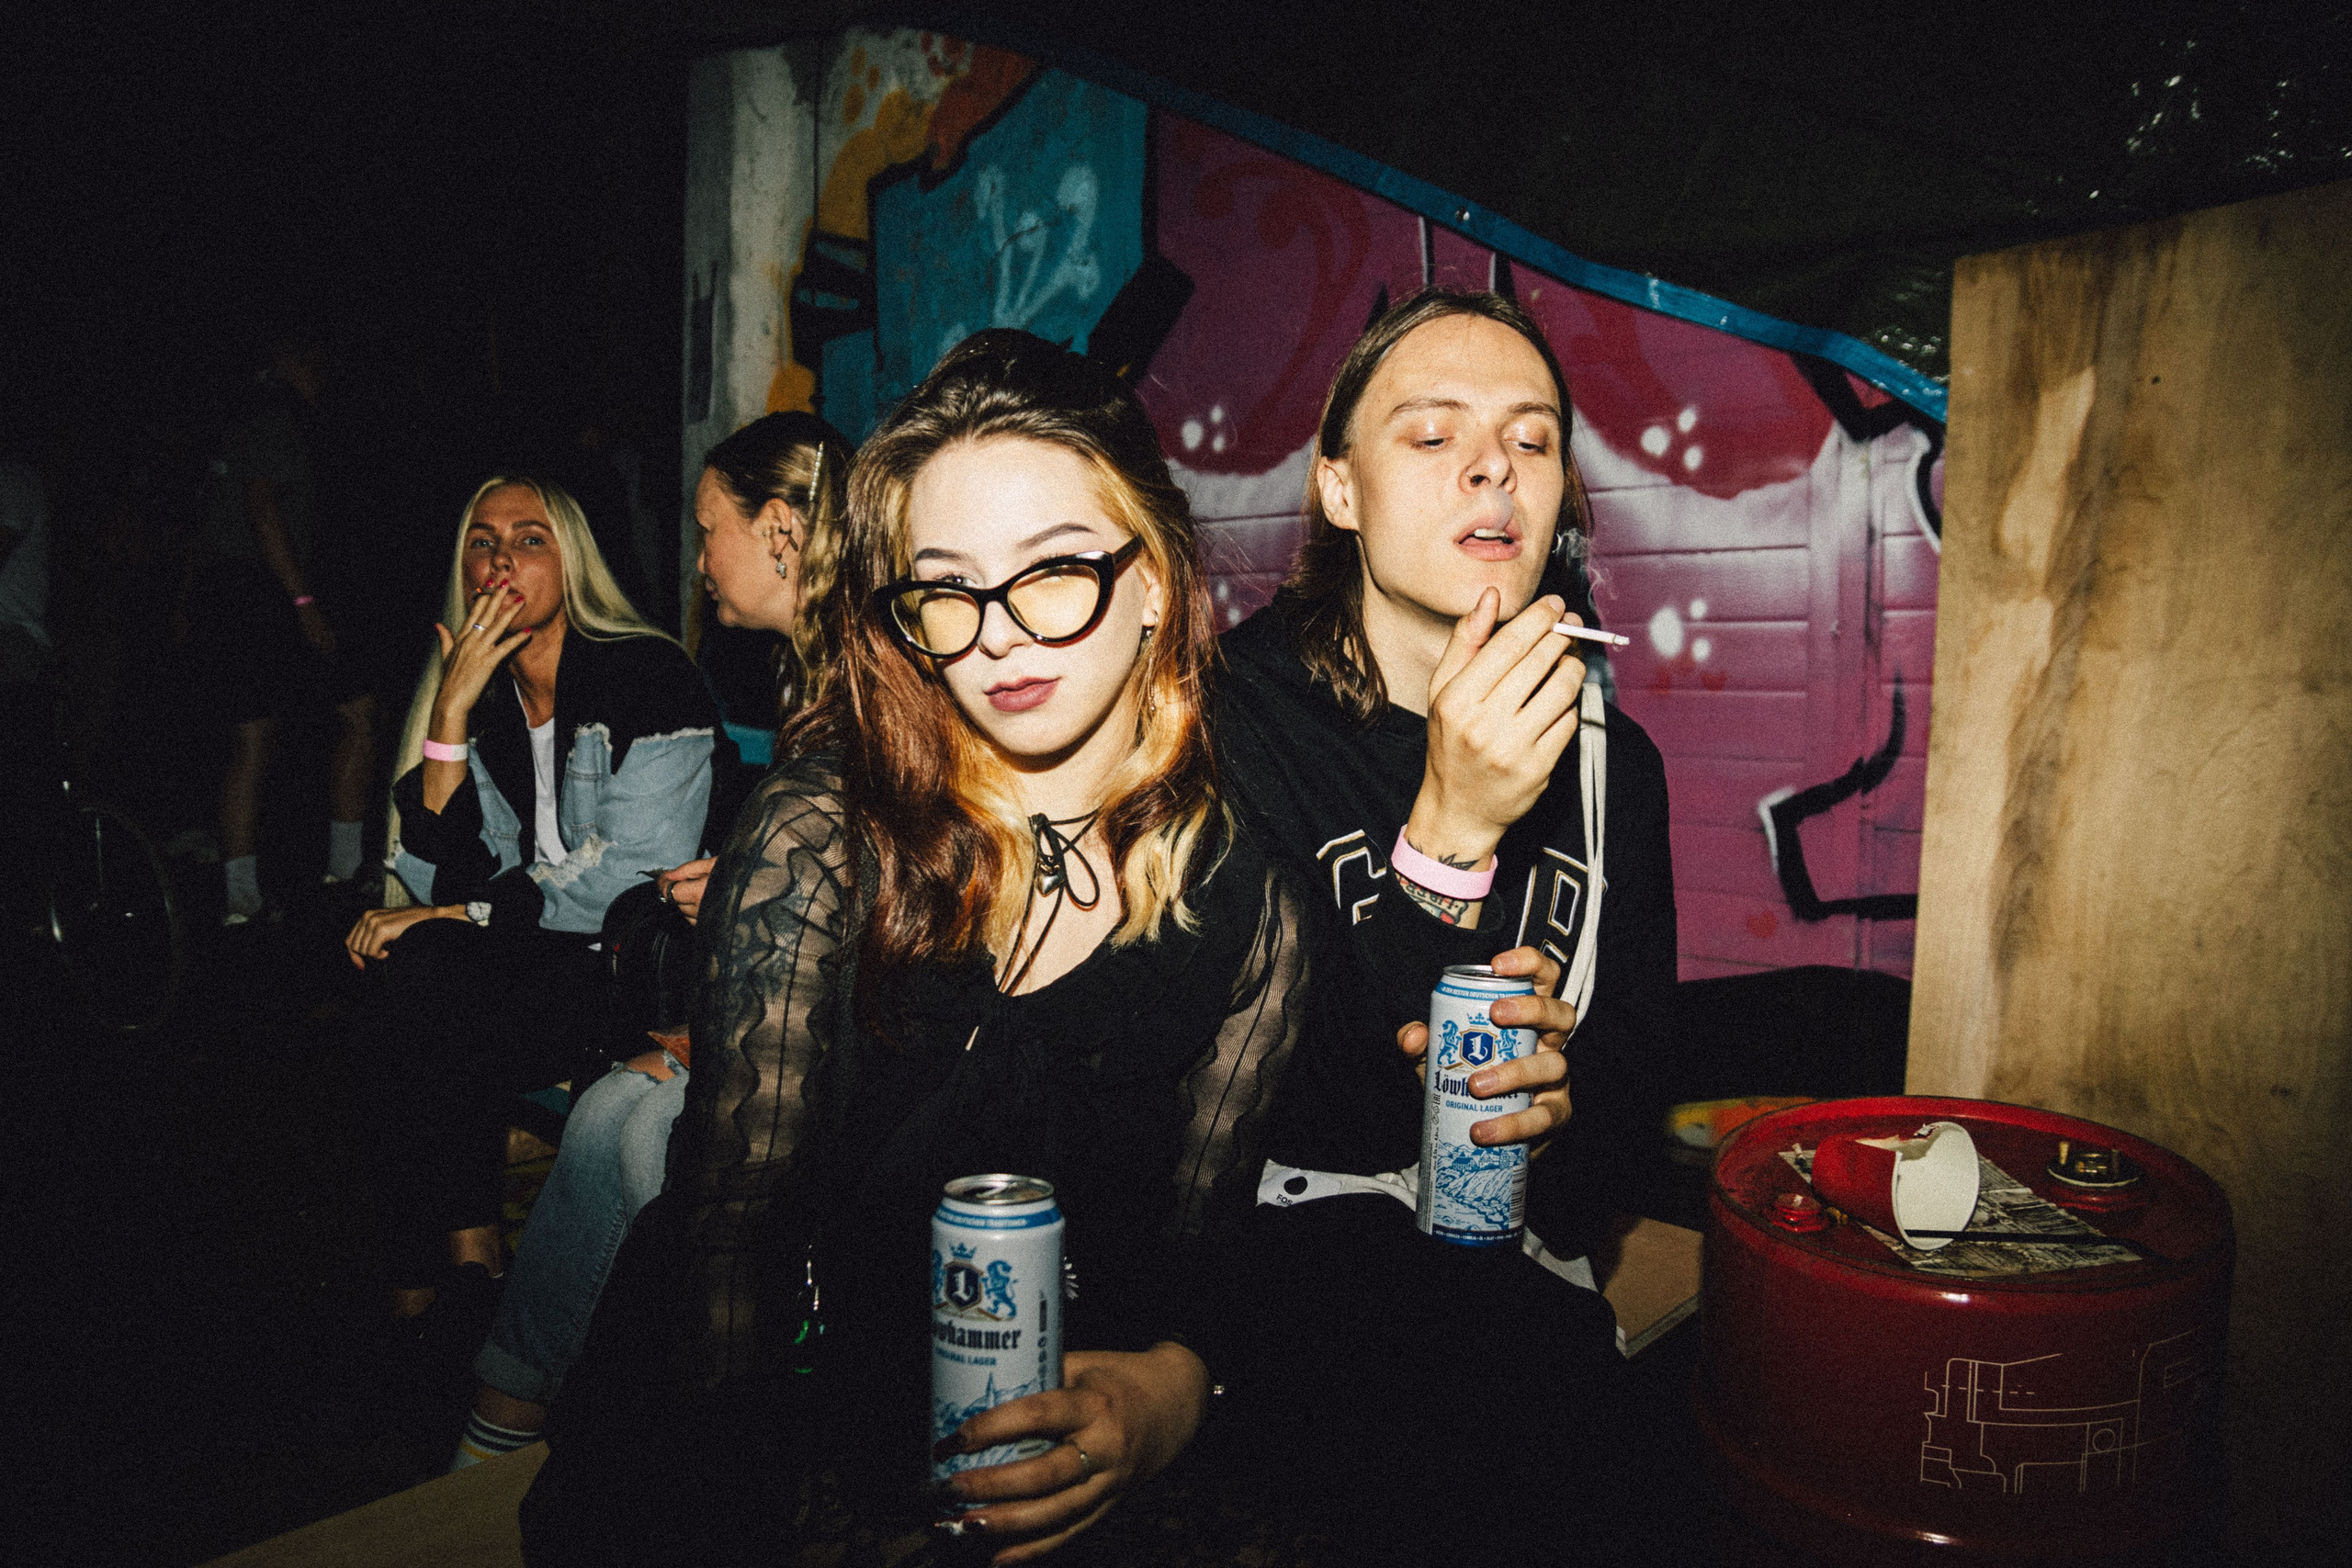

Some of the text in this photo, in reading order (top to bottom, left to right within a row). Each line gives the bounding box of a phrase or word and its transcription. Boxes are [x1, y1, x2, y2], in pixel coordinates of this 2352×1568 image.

[1468, 1033, 1488, 1061] L
[1445, 1100, 1478, 1111] ORIGINAL
[967, 1356, 996, 1367] LAGER
